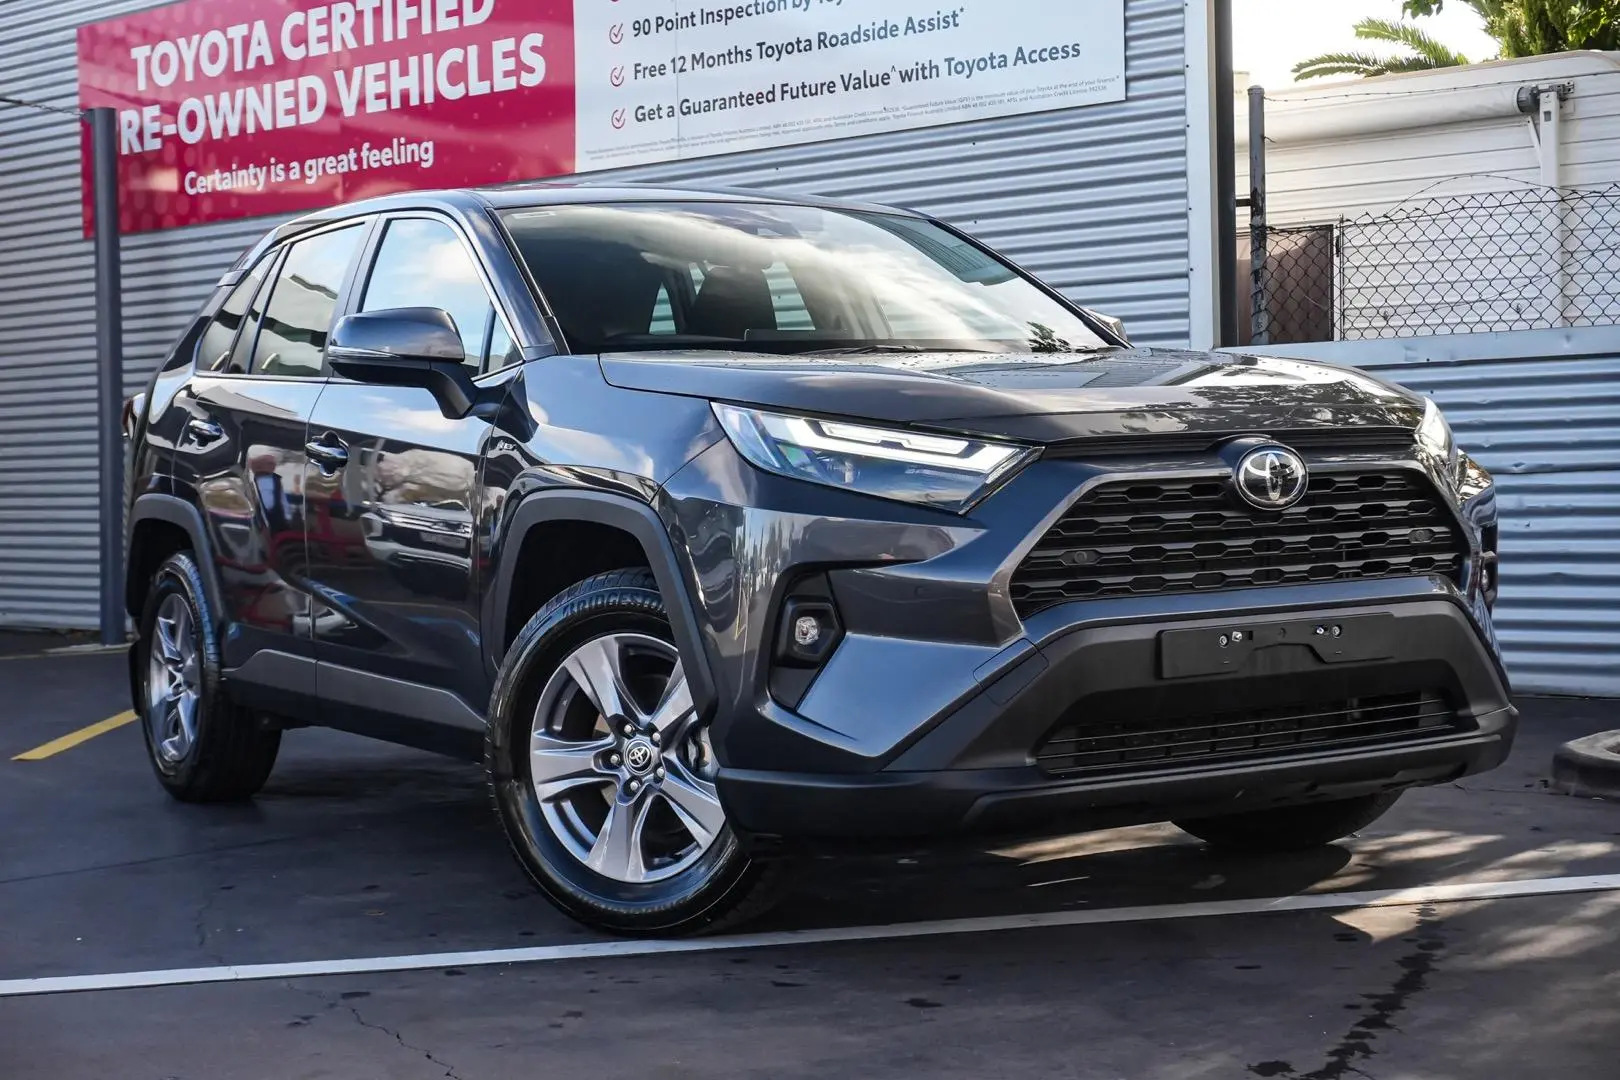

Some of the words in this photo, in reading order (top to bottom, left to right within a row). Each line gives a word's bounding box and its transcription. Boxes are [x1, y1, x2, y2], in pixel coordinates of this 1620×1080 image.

[131, 20, 273, 91] TOYOTA
[281, 0, 494, 61] CERTIFIED
[632, 18, 651, 37] 90
[655, 12, 696, 33] Point
[701, 0, 787, 25] Inspection
[634, 63, 666, 80] Free
[670, 56, 687, 74] 12
[691, 45, 752, 71] Months
[756, 36, 813, 61] Toyota
[818, 20, 899, 50] Roadside
[120, 77, 326, 155] RE-OWNED
[333, 32, 546, 117] VEHICLES
[635, 104, 663, 123] Get
[667, 105, 676, 118] a
[680, 85, 776, 116] Guaranteed
[781, 79, 836, 101] Future
[899, 59, 939, 83] with
[944, 52, 1008, 78] Toyota
[1013, 42, 1081, 67] Access
[185, 160, 267, 196] Certainty
[270, 158, 285, 182] is
[289, 161, 301, 180] a
[305, 148, 358, 184] great
[360, 137, 434, 171] feeling
